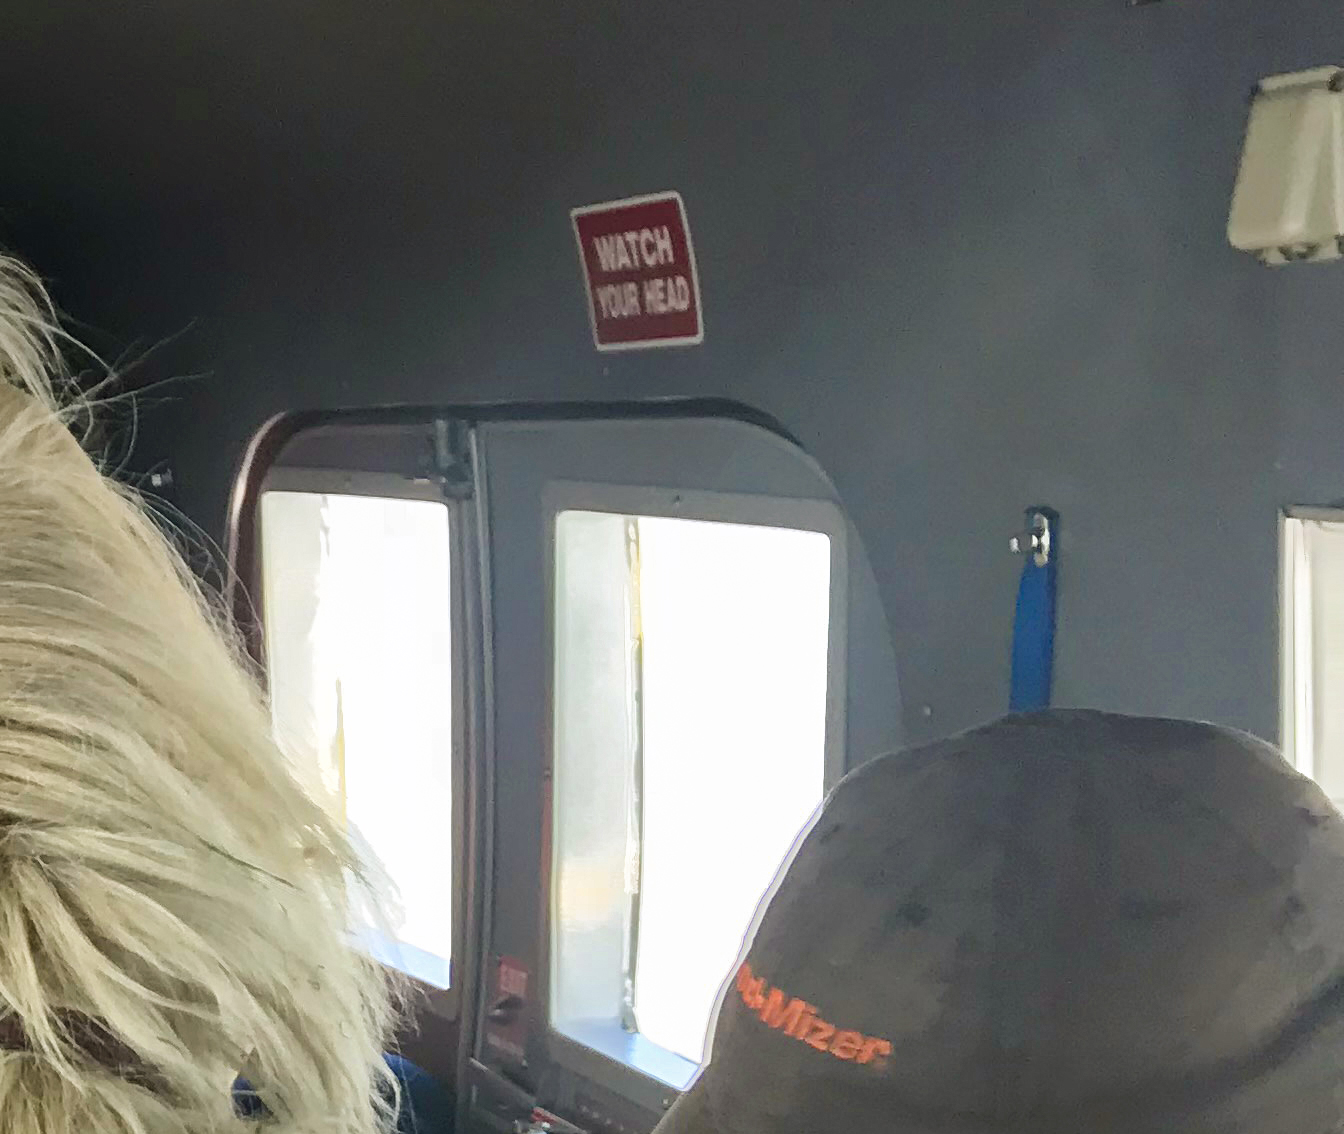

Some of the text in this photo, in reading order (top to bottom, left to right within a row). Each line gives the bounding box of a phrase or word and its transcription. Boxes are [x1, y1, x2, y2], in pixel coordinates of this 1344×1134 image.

[593, 225, 674, 272] WATCH
[596, 275, 690, 319] YOUR HEAD
